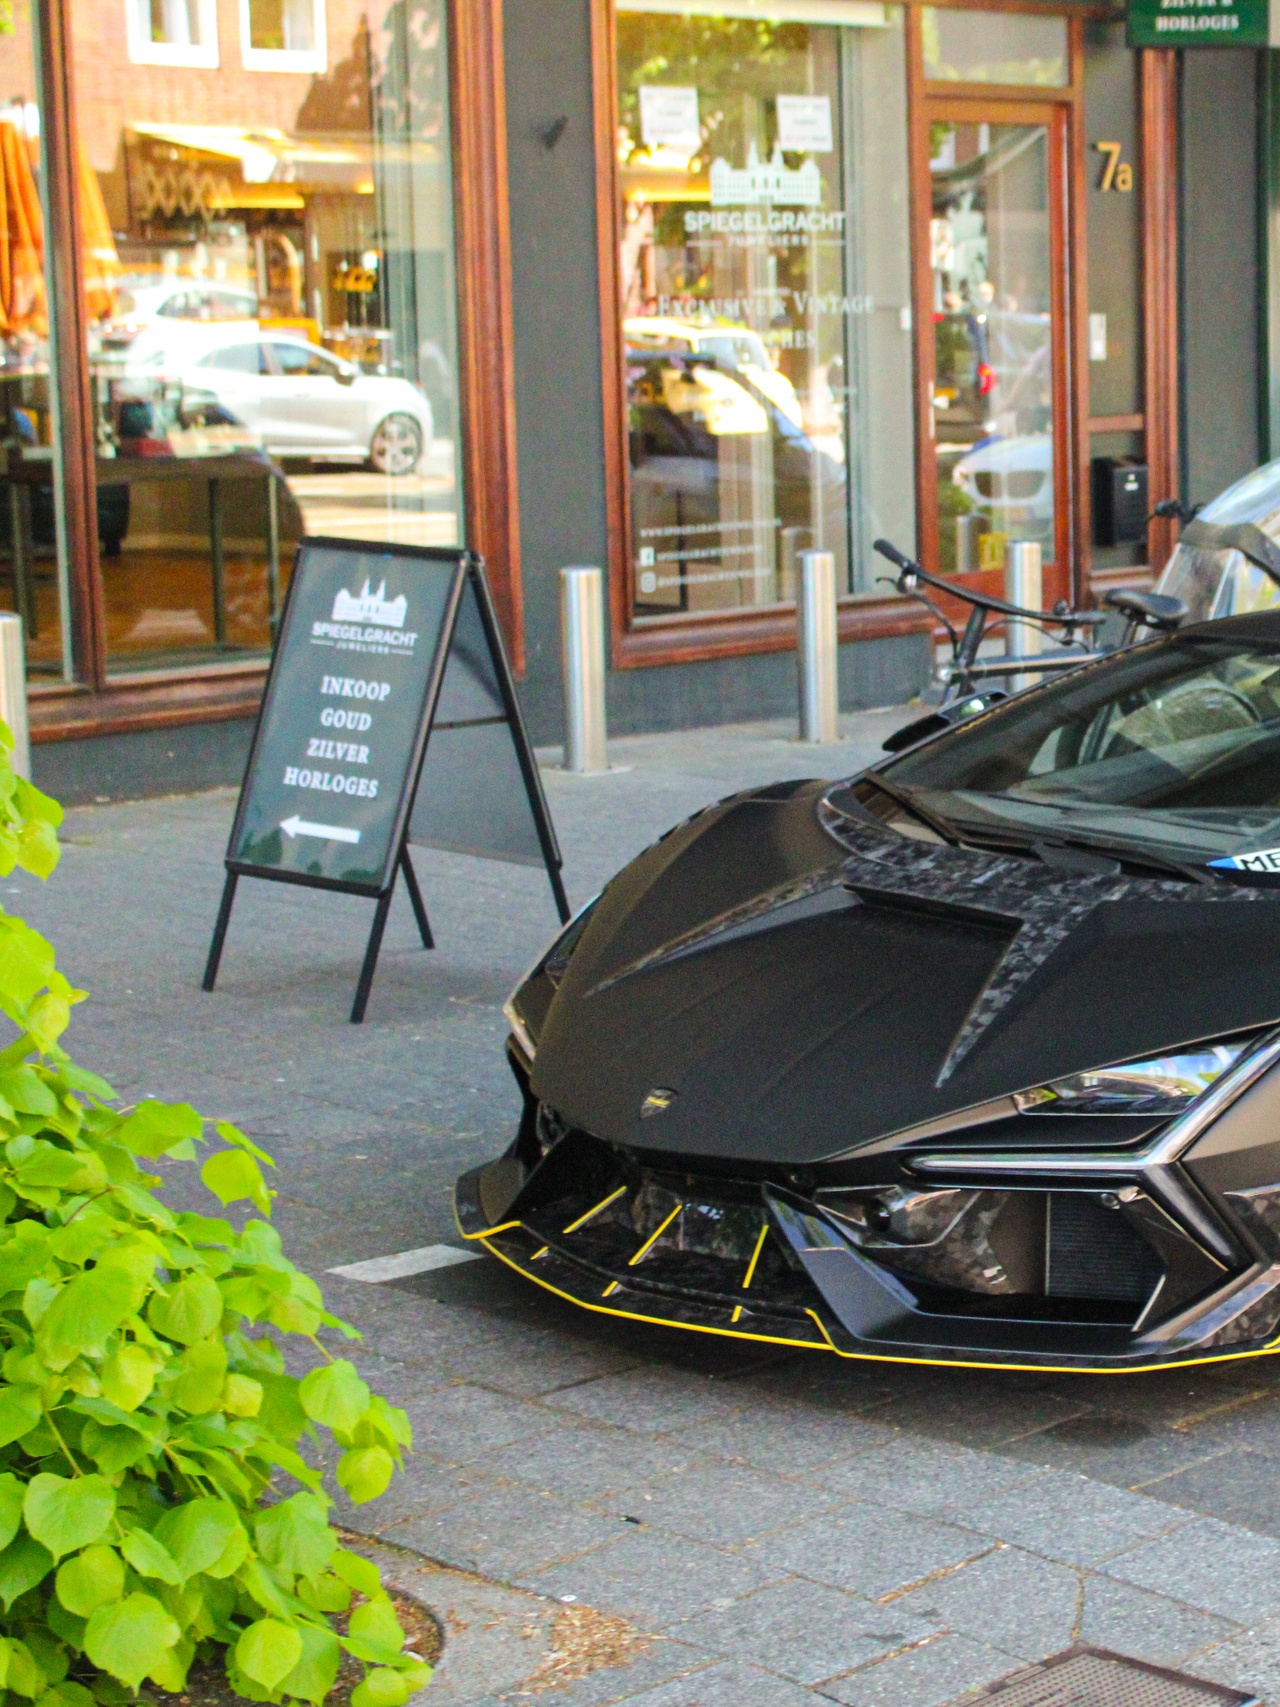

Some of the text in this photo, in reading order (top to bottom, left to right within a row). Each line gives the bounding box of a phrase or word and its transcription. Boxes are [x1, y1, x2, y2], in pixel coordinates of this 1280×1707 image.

[1156, 15, 1239, 31] HORLOGES
[1097, 142, 1133, 192] 7a
[684, 210, 846, 232] SPIEGELGRACHT
[312, 621, 418, 647] SPIEGELGRACHT
[321, 676, 391, 701] INKOOP
[321, 708, 372, 731] GOUD
[307, 738, 369, 764] ZILVER
[283, 766, 379, 798] HORLOGES
